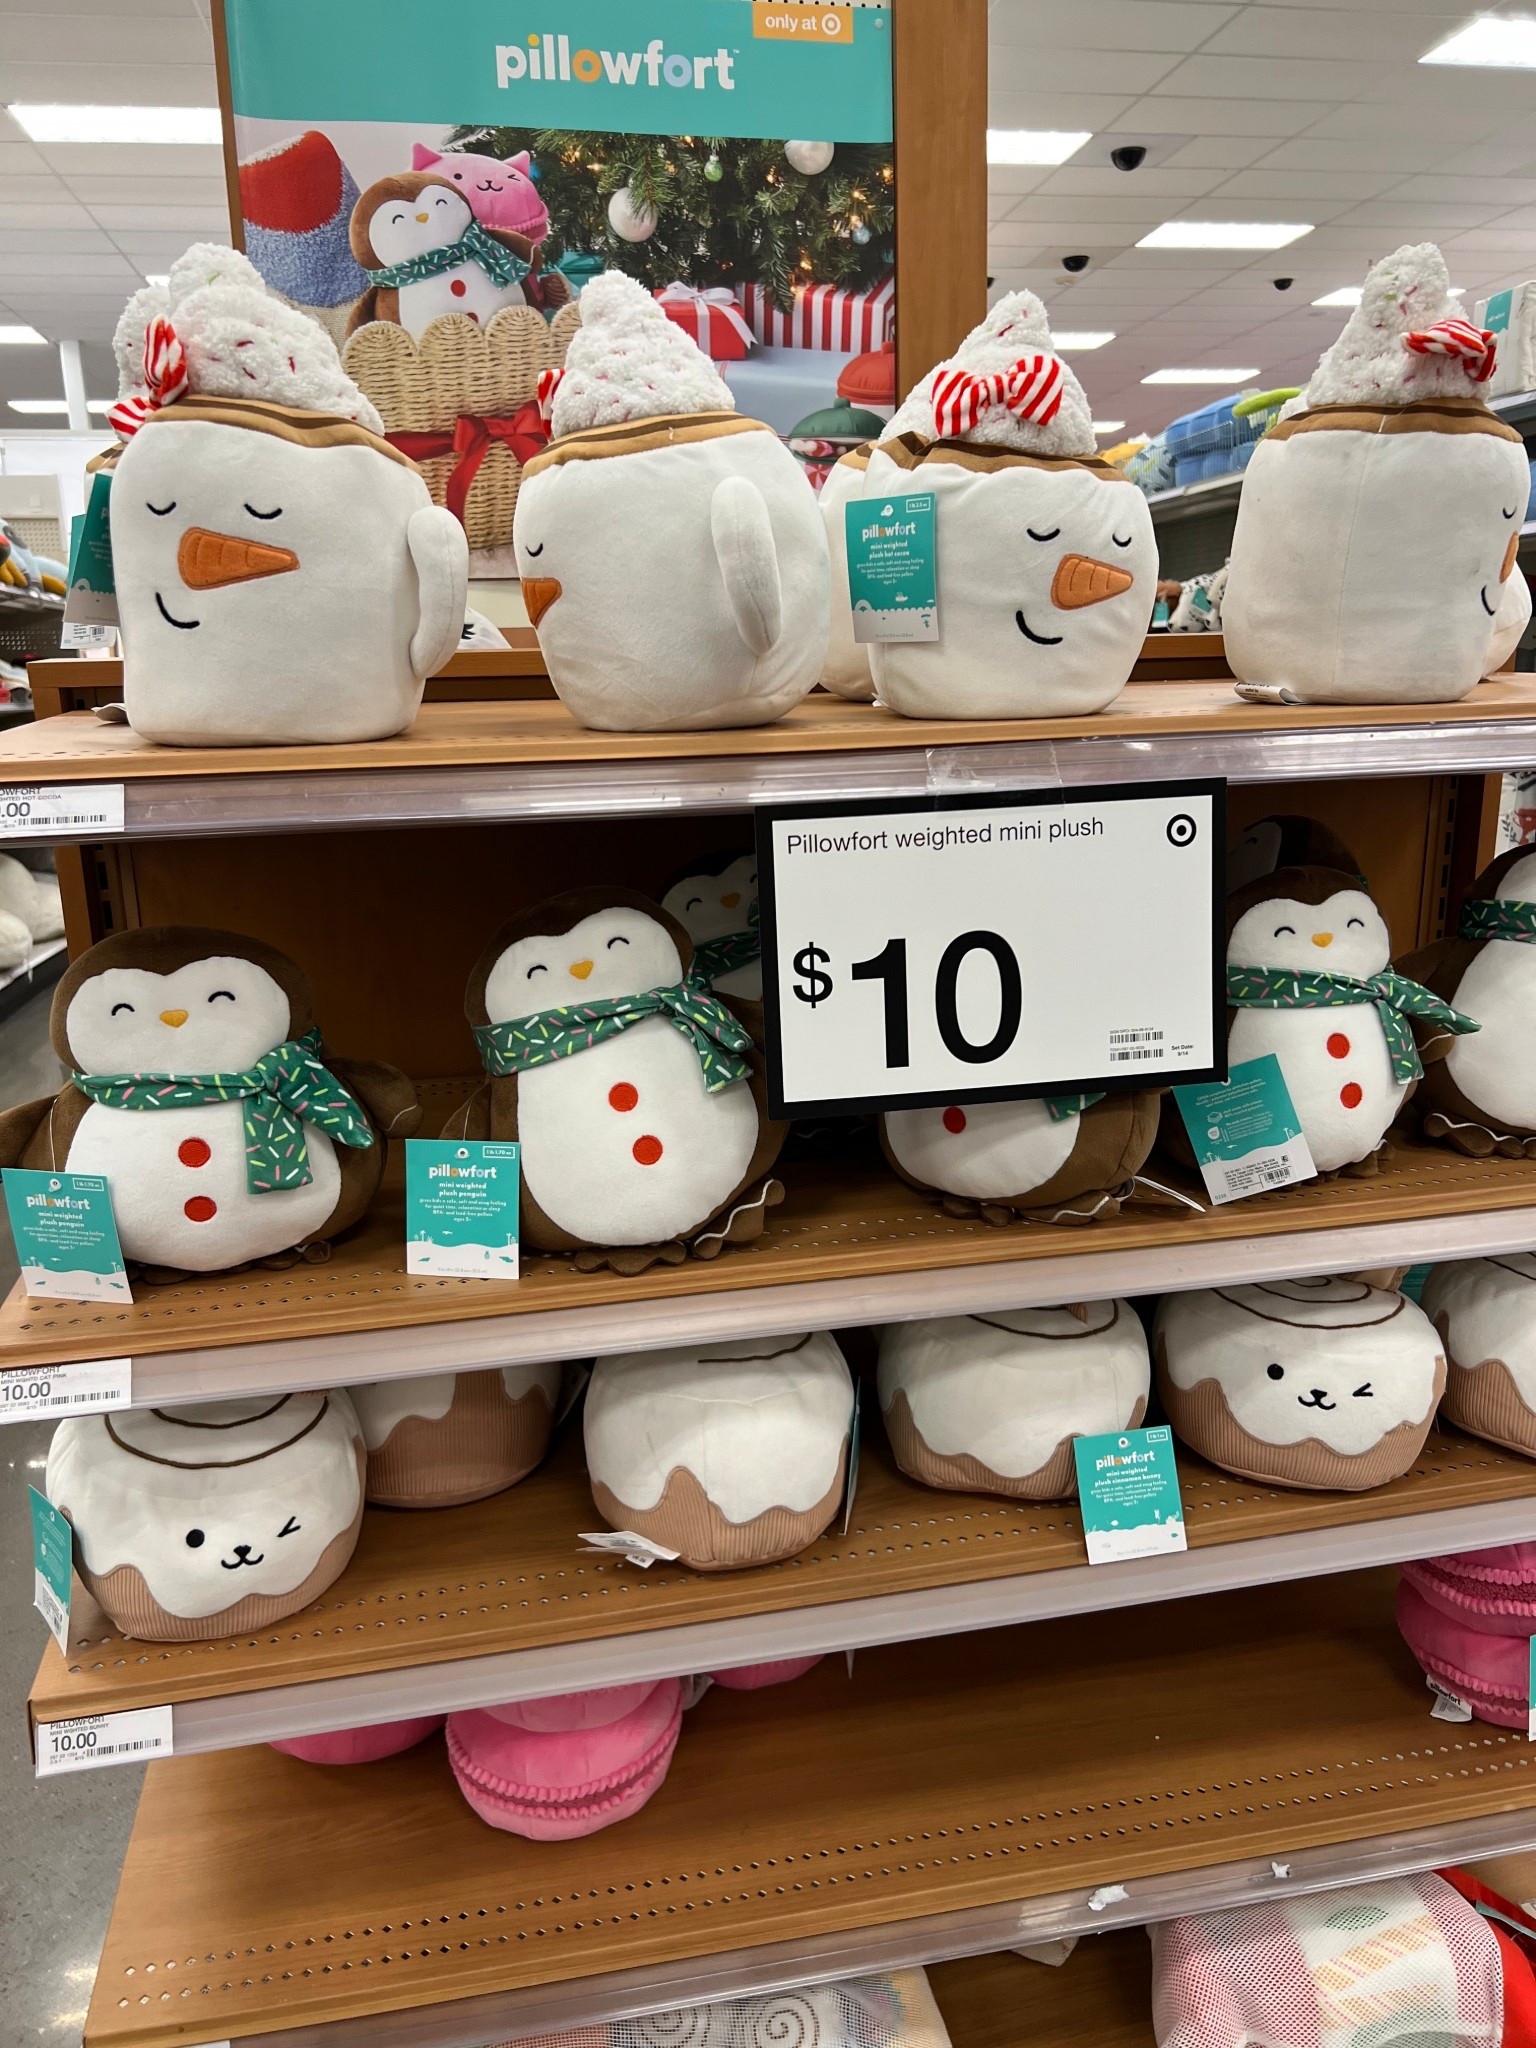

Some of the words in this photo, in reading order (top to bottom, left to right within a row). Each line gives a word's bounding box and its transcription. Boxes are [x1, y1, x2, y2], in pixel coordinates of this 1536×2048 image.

[765, 16, 800, 33] only
[803, 16, 817, 31] at
[495, 34, 736, 90] pillowfort
[862, 522, 916, 542] pillowfort
[870, 542, 882, 550] mini
[884, 540, 908, 550] weighted
[869, 551, 883, 560] plush
[884, 550, 893, 558] hot
[0, 802, 30, 818] .00
[787, 832, 888, 855] Pillowfort
[895, 824, 992, 851] weighted
[999, 820, 1042, 842] mini
[1049, 817, 1104, 843] plush
[429, 1164, 497, 1179] pillowfort
[439, 1189, 457, 1197] plush
[456, 1182, 487, 1190] weighted
[26, 1194, 90, 1210] pillowfort
[54, 1212, 83, 1220] weighted
[2, 1382, 51, 1401] 10.00
[1096, 1450, 1155, 1471] pillowfort
[1121, 1466, 1148, 1475] weighted
[1095, 1479, 1111, 1487] plush
[1112, 1476, 1142, 1484] cinnamon
[52, 1732, 97, 1752] 10.00
